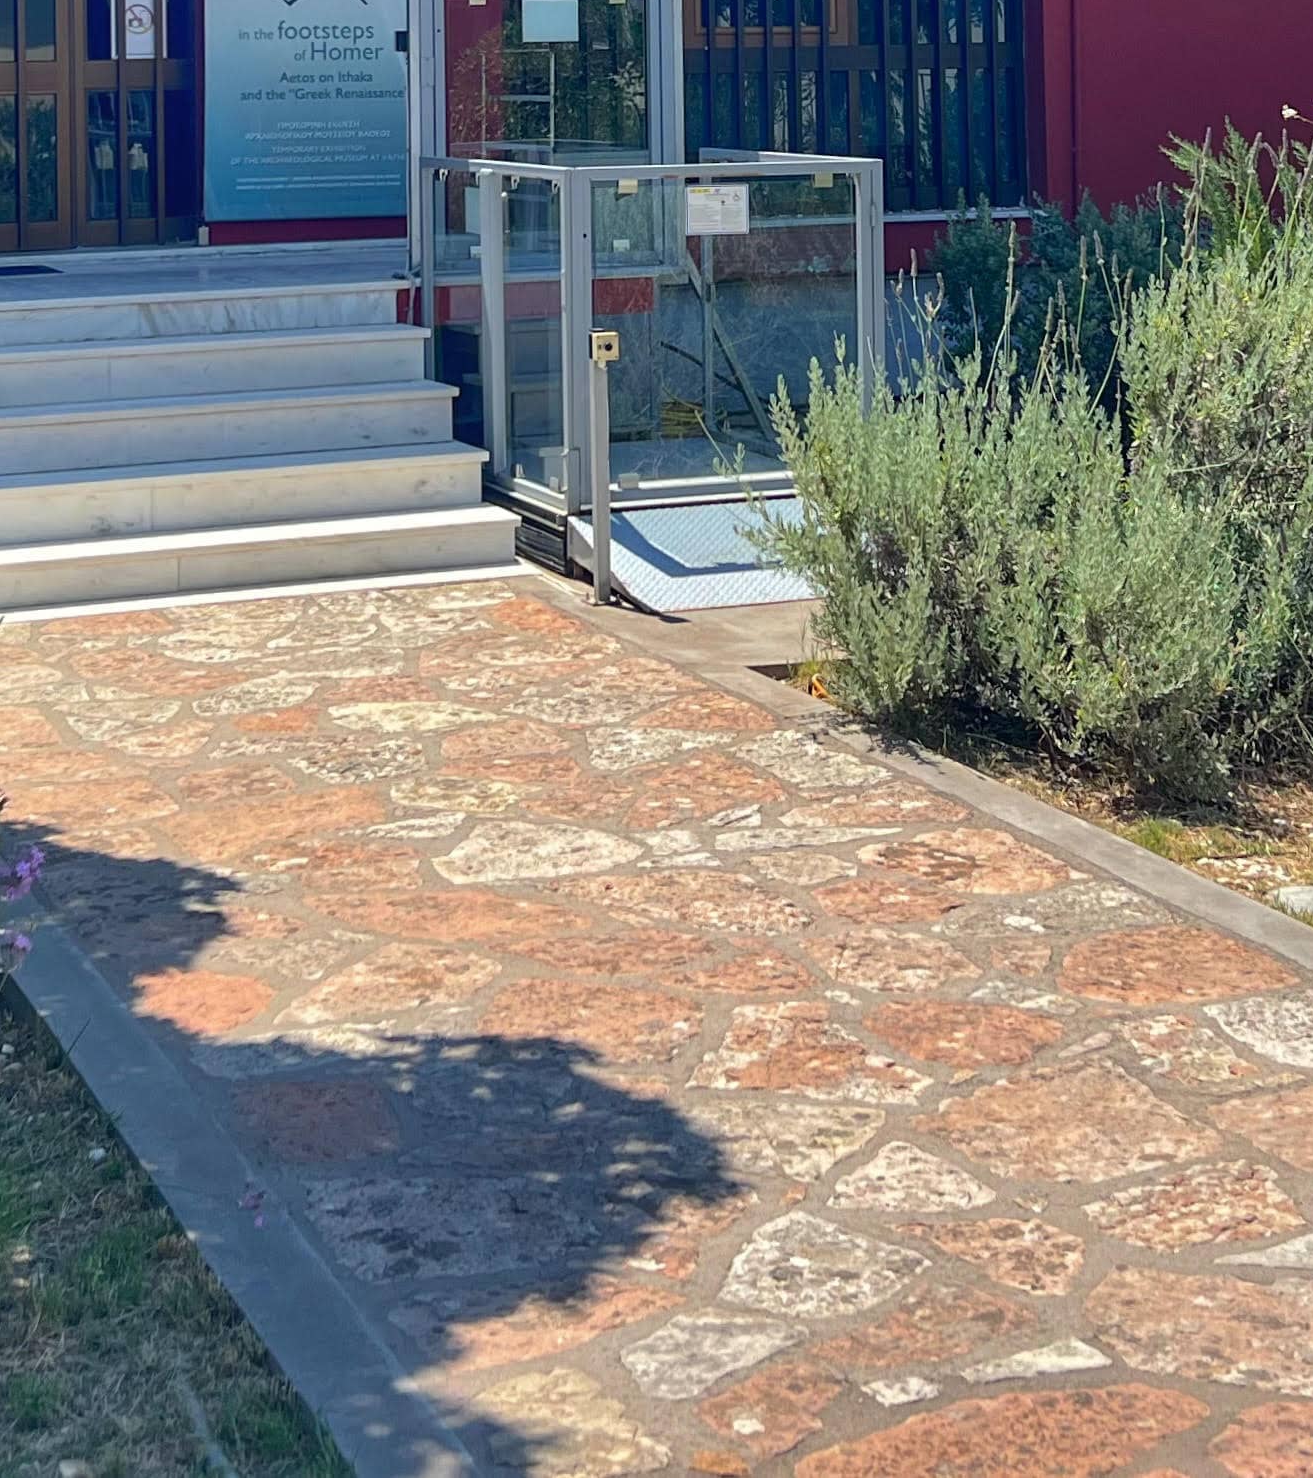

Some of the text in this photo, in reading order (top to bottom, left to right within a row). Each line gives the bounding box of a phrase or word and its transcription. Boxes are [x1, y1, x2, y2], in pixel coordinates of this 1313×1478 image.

[238, 20, 375, 44] in the footsteps
[294, 41, 384, 61] of Homer
[279, 71, 373, 84] Aetos on Ithaka
[240, 89, 262, 101] and
[265, 88, 286, 100] the
